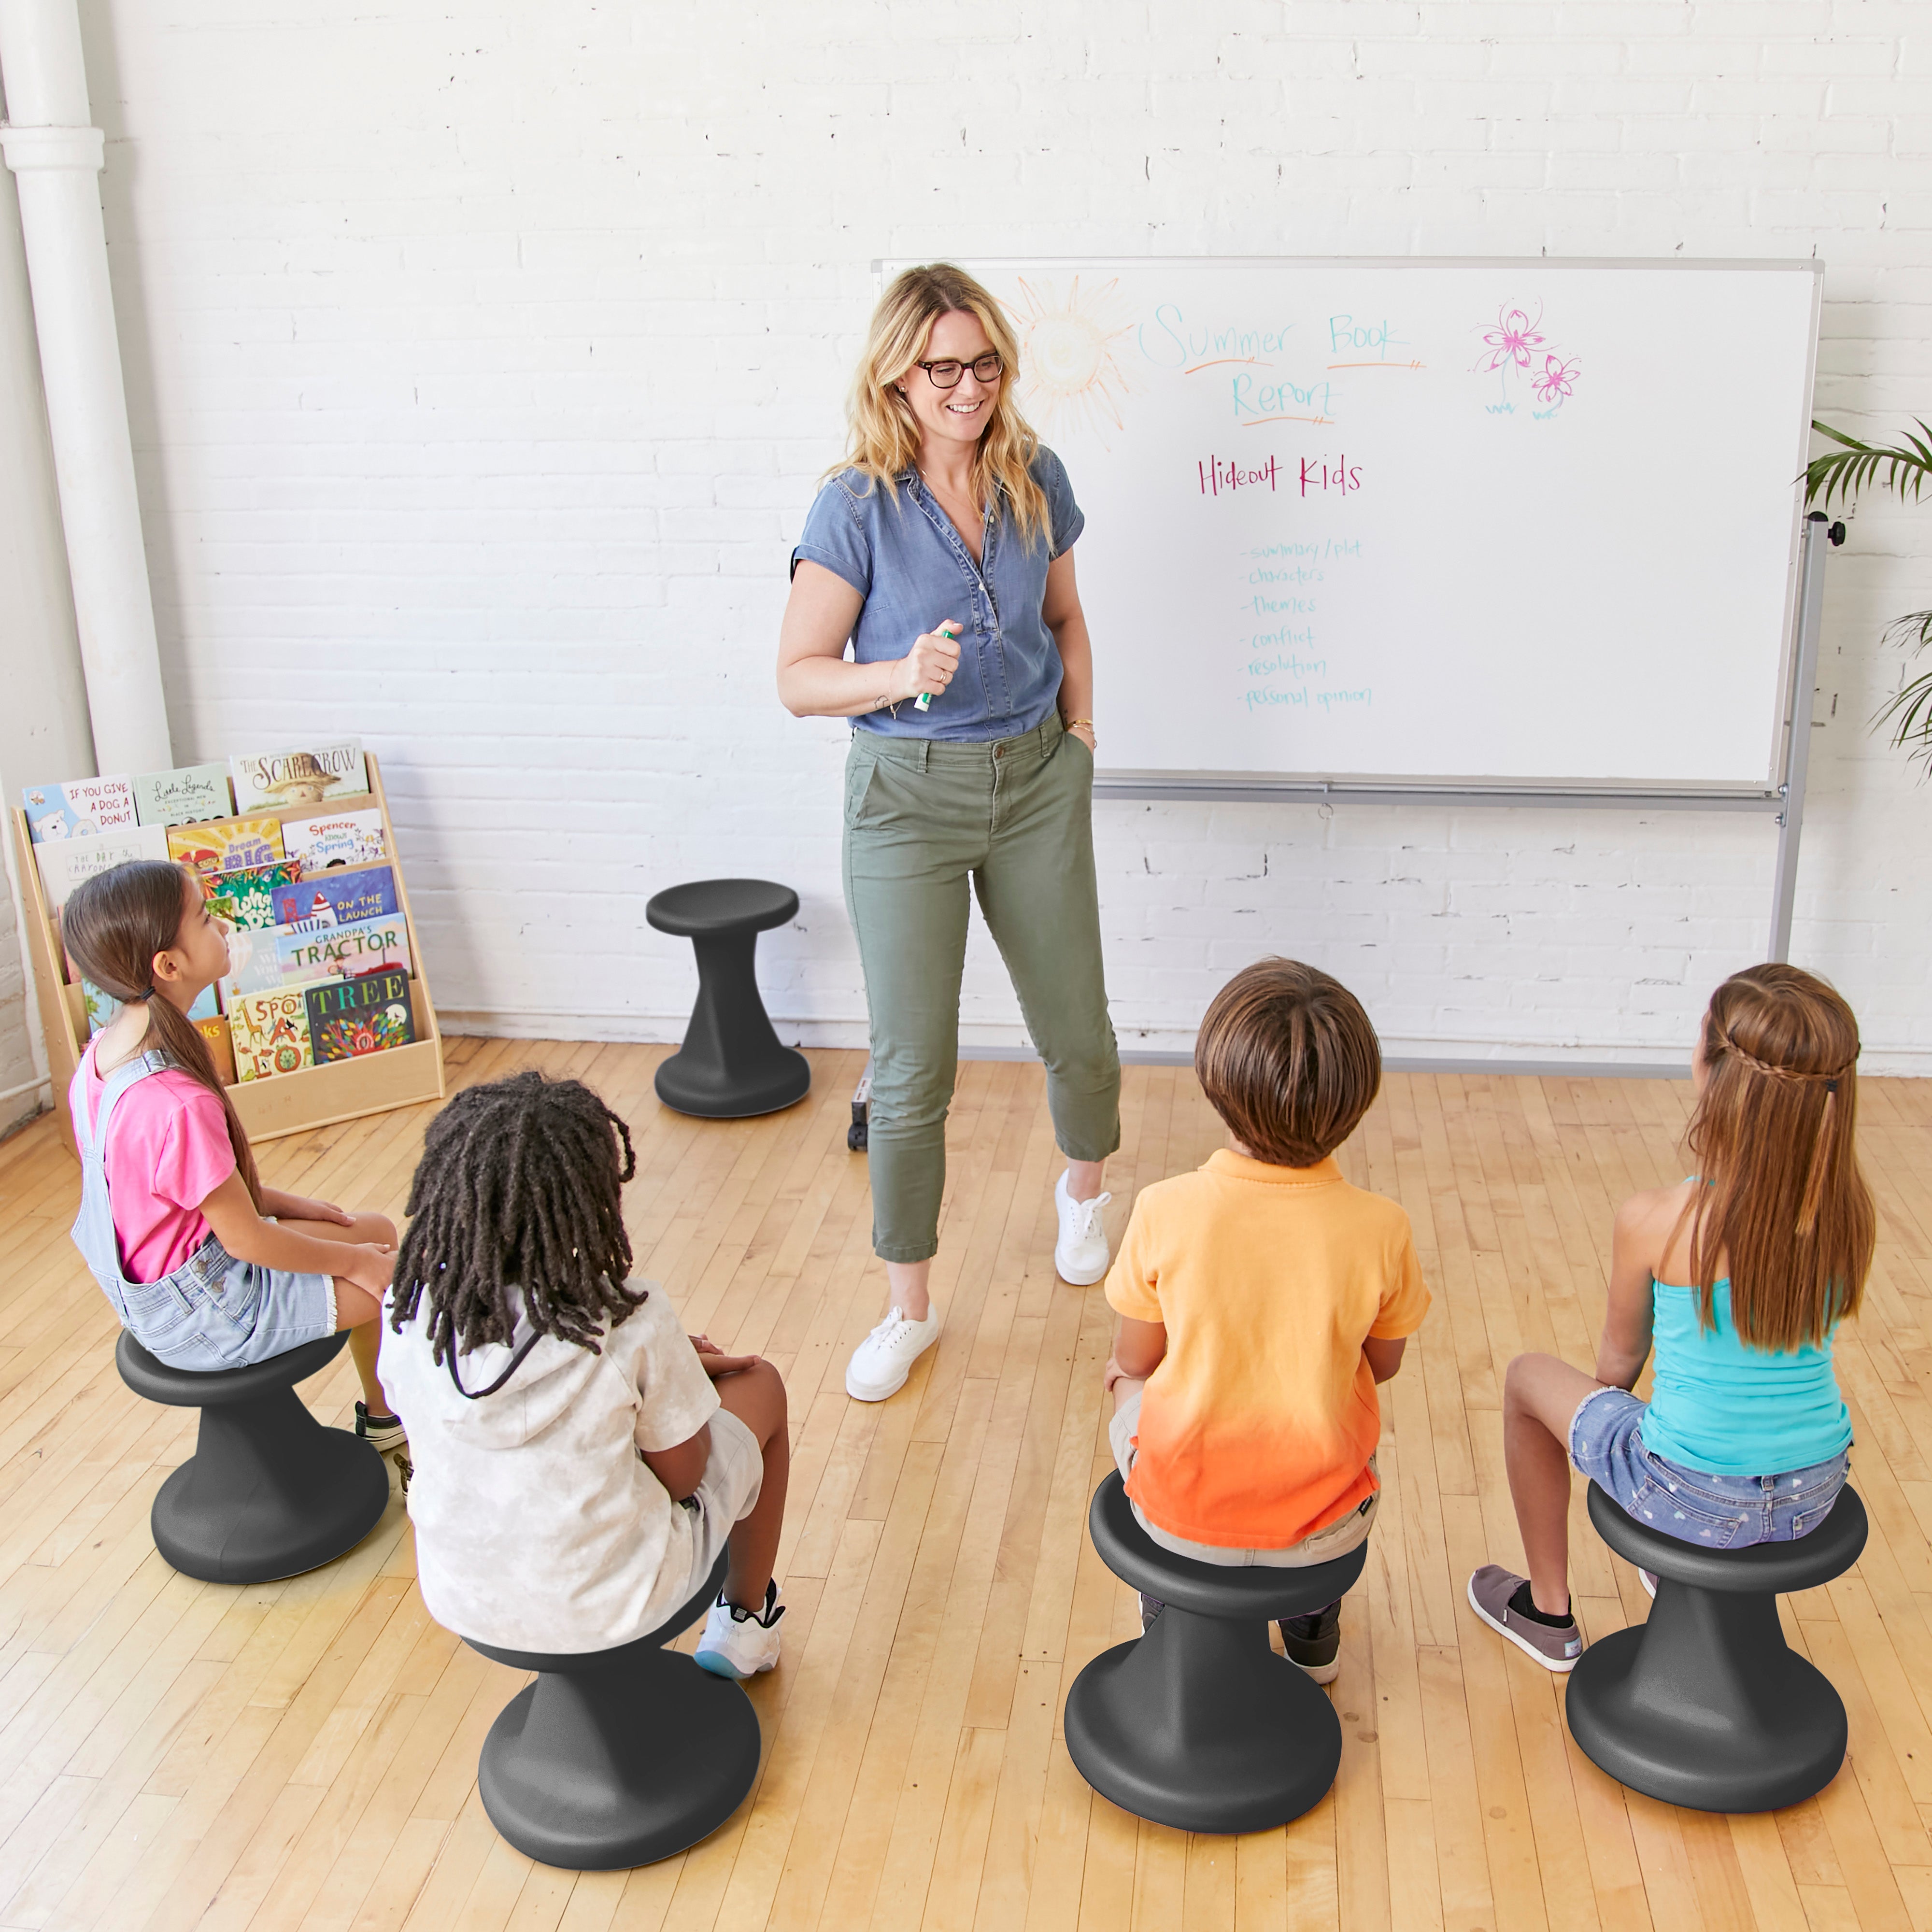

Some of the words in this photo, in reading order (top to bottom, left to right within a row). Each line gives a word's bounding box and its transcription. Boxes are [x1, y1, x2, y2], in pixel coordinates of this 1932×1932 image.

[1138, 304, 1298, 367] Summer
[1330, 314, 1411, 361] Book
[1233, 373, 1343, 416] Report
[1198, 454, 1284, 496] Hideout
[1299, 454, 1363, 497] Kids
[1317, 687, 1372, 712] opinion
[240, 759, 258, 773] THE
[253, 748, 356, 790] SCARECROW
[70, 789, 79, 800] IF
[83, 786, 101, 797] YOU
[104, 783, 128, 794] GIVE
[152, 781, 181, 802] Little
[181, 774, 215, 794] Legends
[91, 802, 97, 812] A
[99, 799, 120, 810] DOG
[124, 797, 129, 807] A
[100, 810, 130, 825] DONUT
[309, 822, 356, 836] Spencer
[224, 844, 274, 869] BIG
[228, 838, 261, 853] Dream
[316, 839, 355, 854] Spring
[337, 900, 354, 910] ON
[359, 893, 382, 906] THE
[339, 906, 383, 922] LAUNCH
[315, 925, 372, 944] GRANDPA'S
[291, 930, 398, 966] TRACTOR
[312, 975, 404, 1014] TREE
[256, 999, 298, 1021] SPO
[199, 1024, 220, 1038] ks
[253, 1046, 301, 1079] LO
